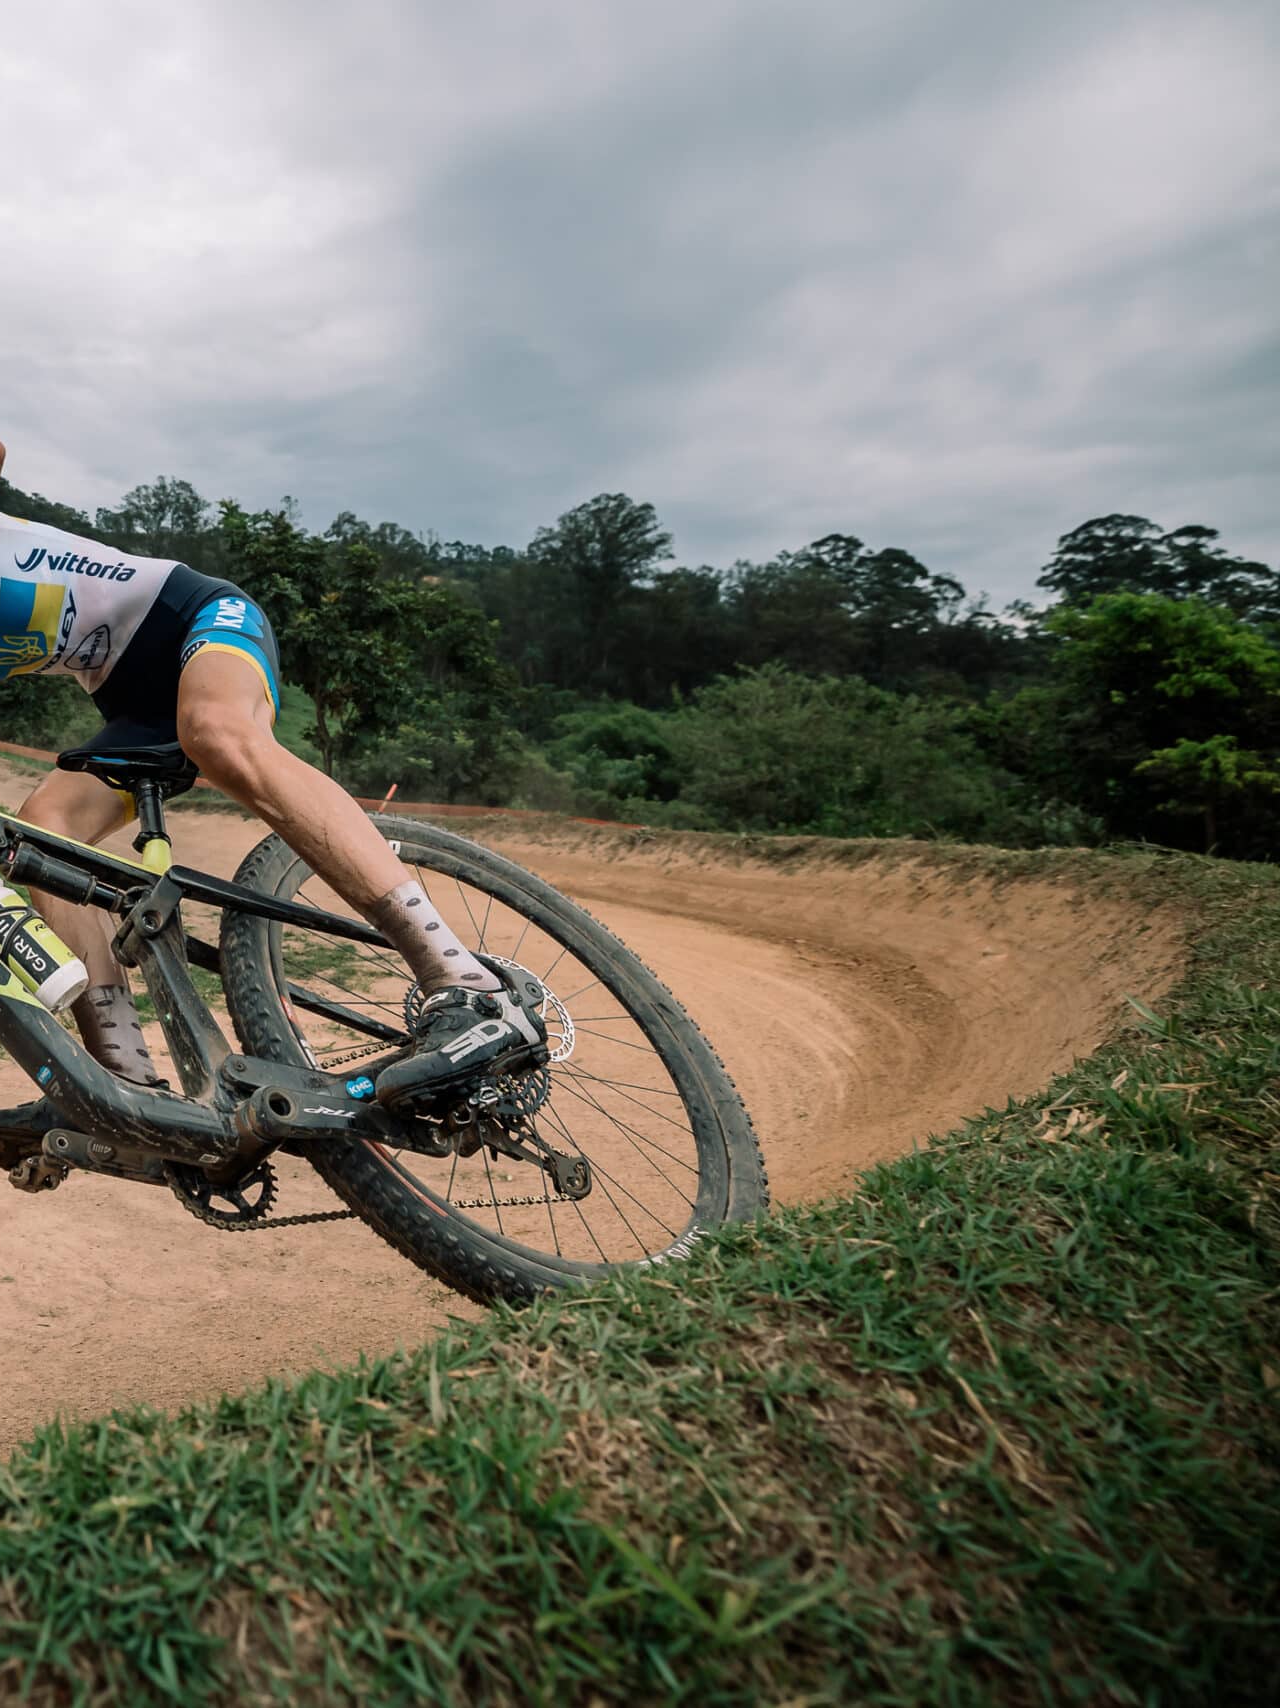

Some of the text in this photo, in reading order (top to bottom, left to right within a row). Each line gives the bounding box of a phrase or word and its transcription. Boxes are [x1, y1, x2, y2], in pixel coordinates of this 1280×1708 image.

[47, 551, 137, 582] vittoria
[213, 598, 246, 628] KMC
[349, 1079, 373, 1095] KMC
